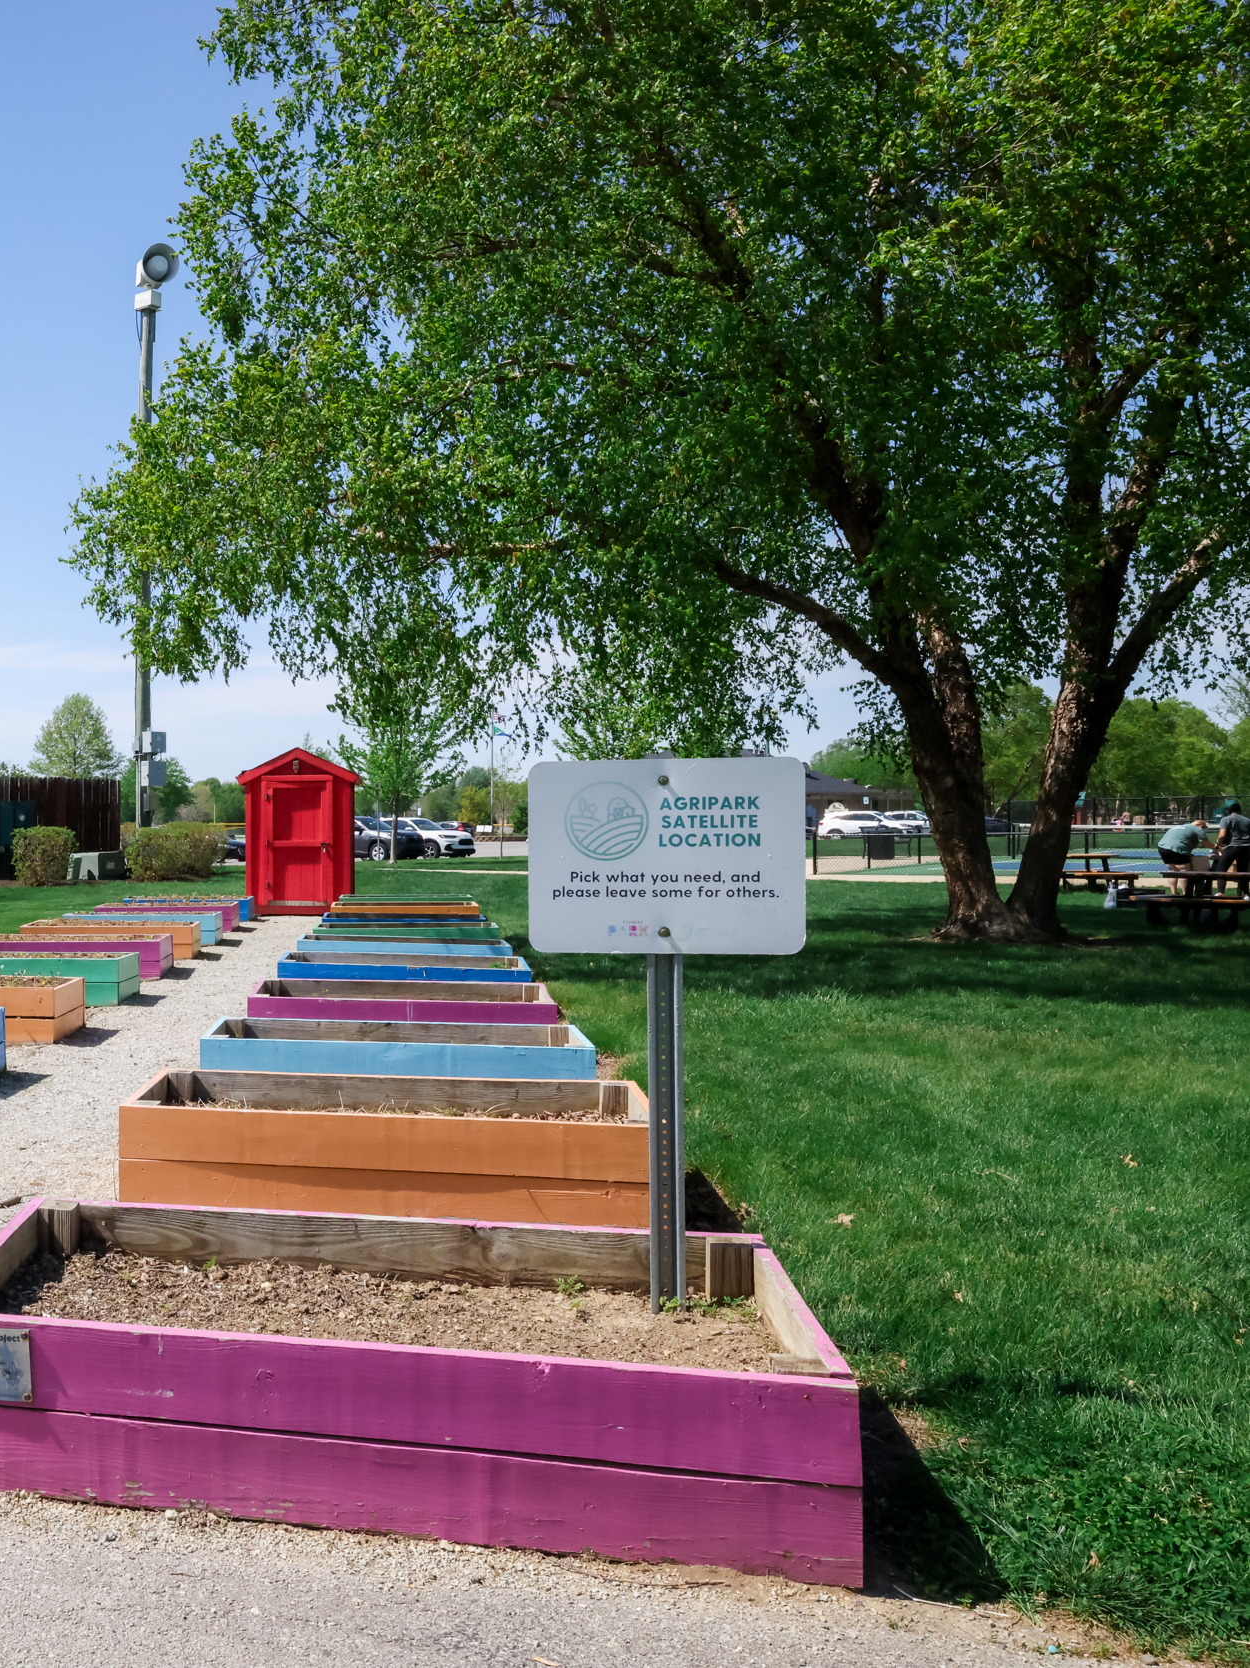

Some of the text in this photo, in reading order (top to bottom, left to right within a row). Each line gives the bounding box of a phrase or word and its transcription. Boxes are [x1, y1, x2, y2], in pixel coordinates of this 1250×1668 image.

[659, 795, 760, 811] AGRIPARK
[661, 814, 759, 829] SATELLITE
[658, 832, 761, 847] LOCATION
[570, 871, 761, 885] Pick what you need, and
[552, 886, 780, 900] please leave some for others.
